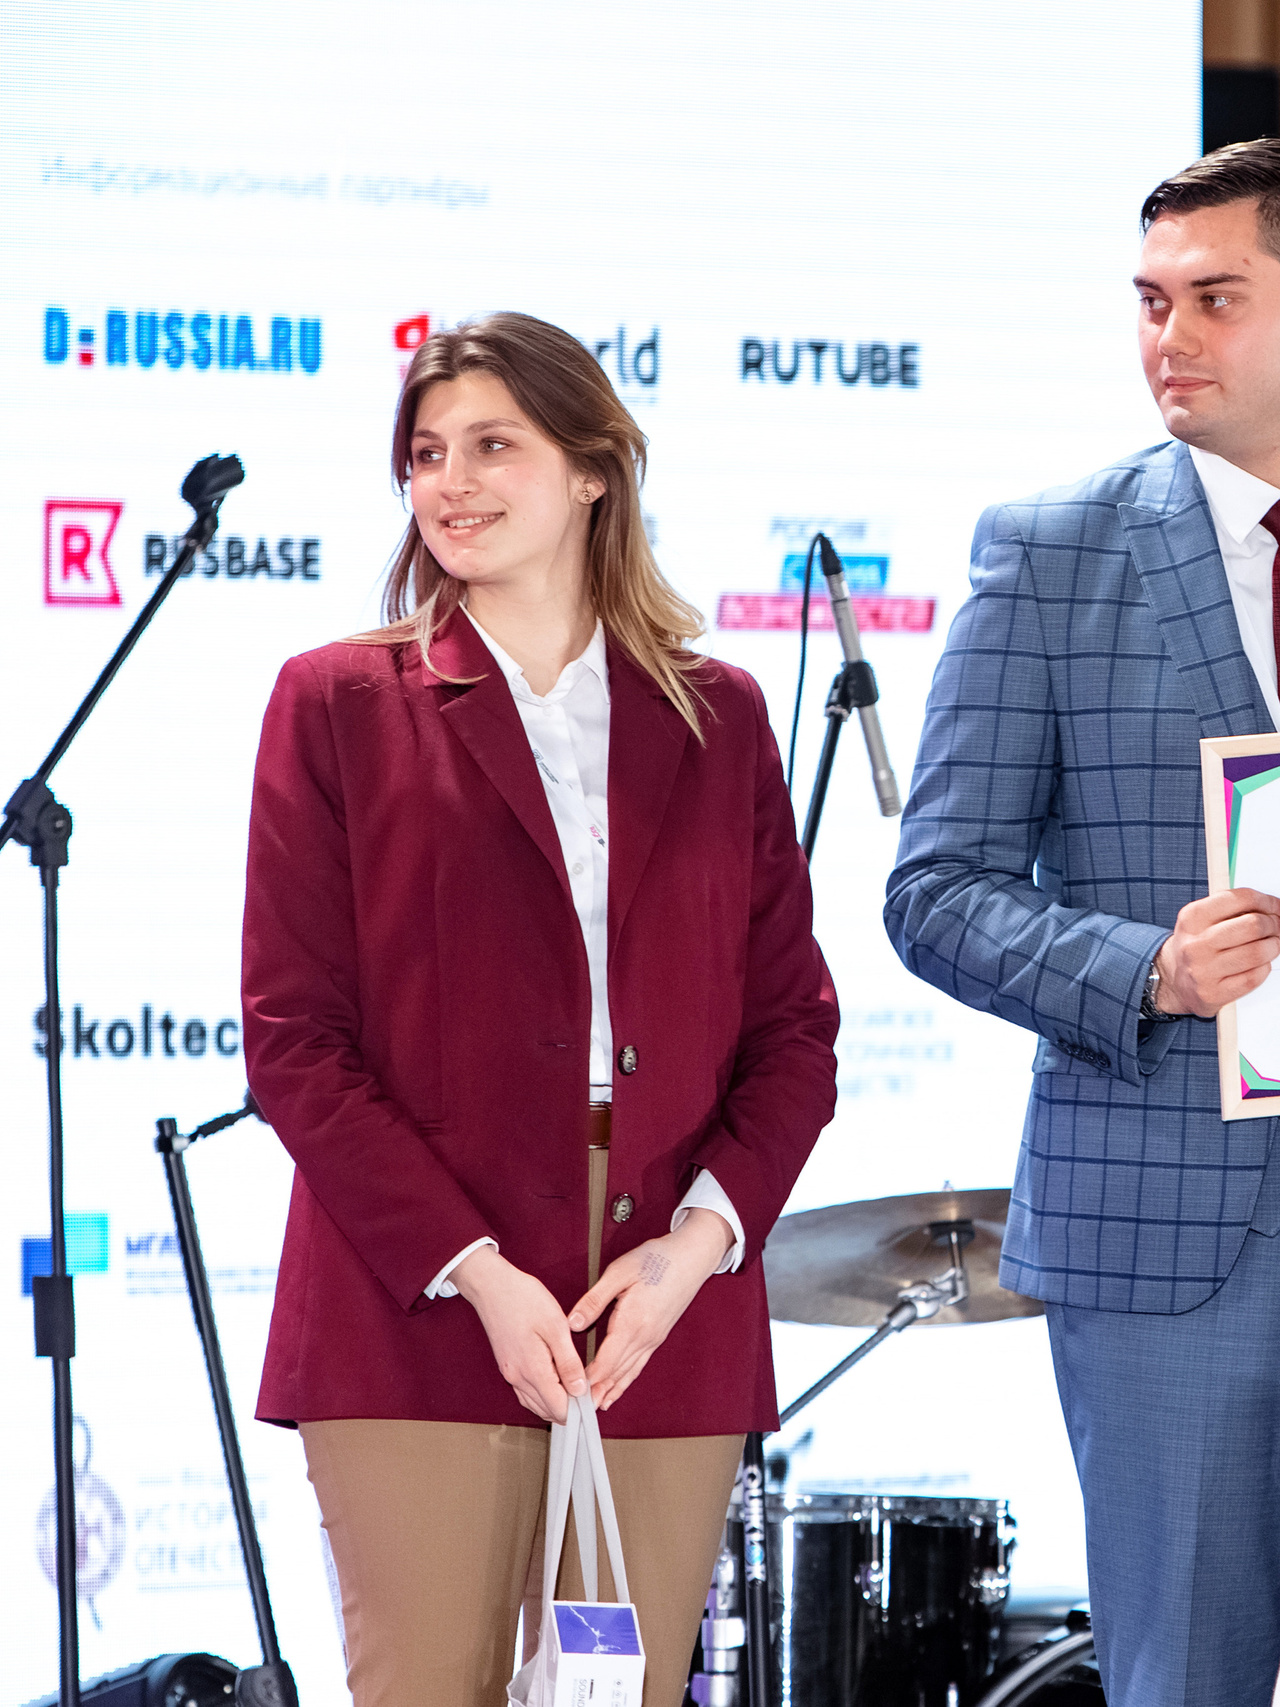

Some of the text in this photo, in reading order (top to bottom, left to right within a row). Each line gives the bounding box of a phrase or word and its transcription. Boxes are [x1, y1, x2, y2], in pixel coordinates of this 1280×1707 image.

[742, 336, 920, 388] RUTUBE
[34, 1004, 240, 1058] Skoltec
[578, 1679, 588, 1707] SOUND
